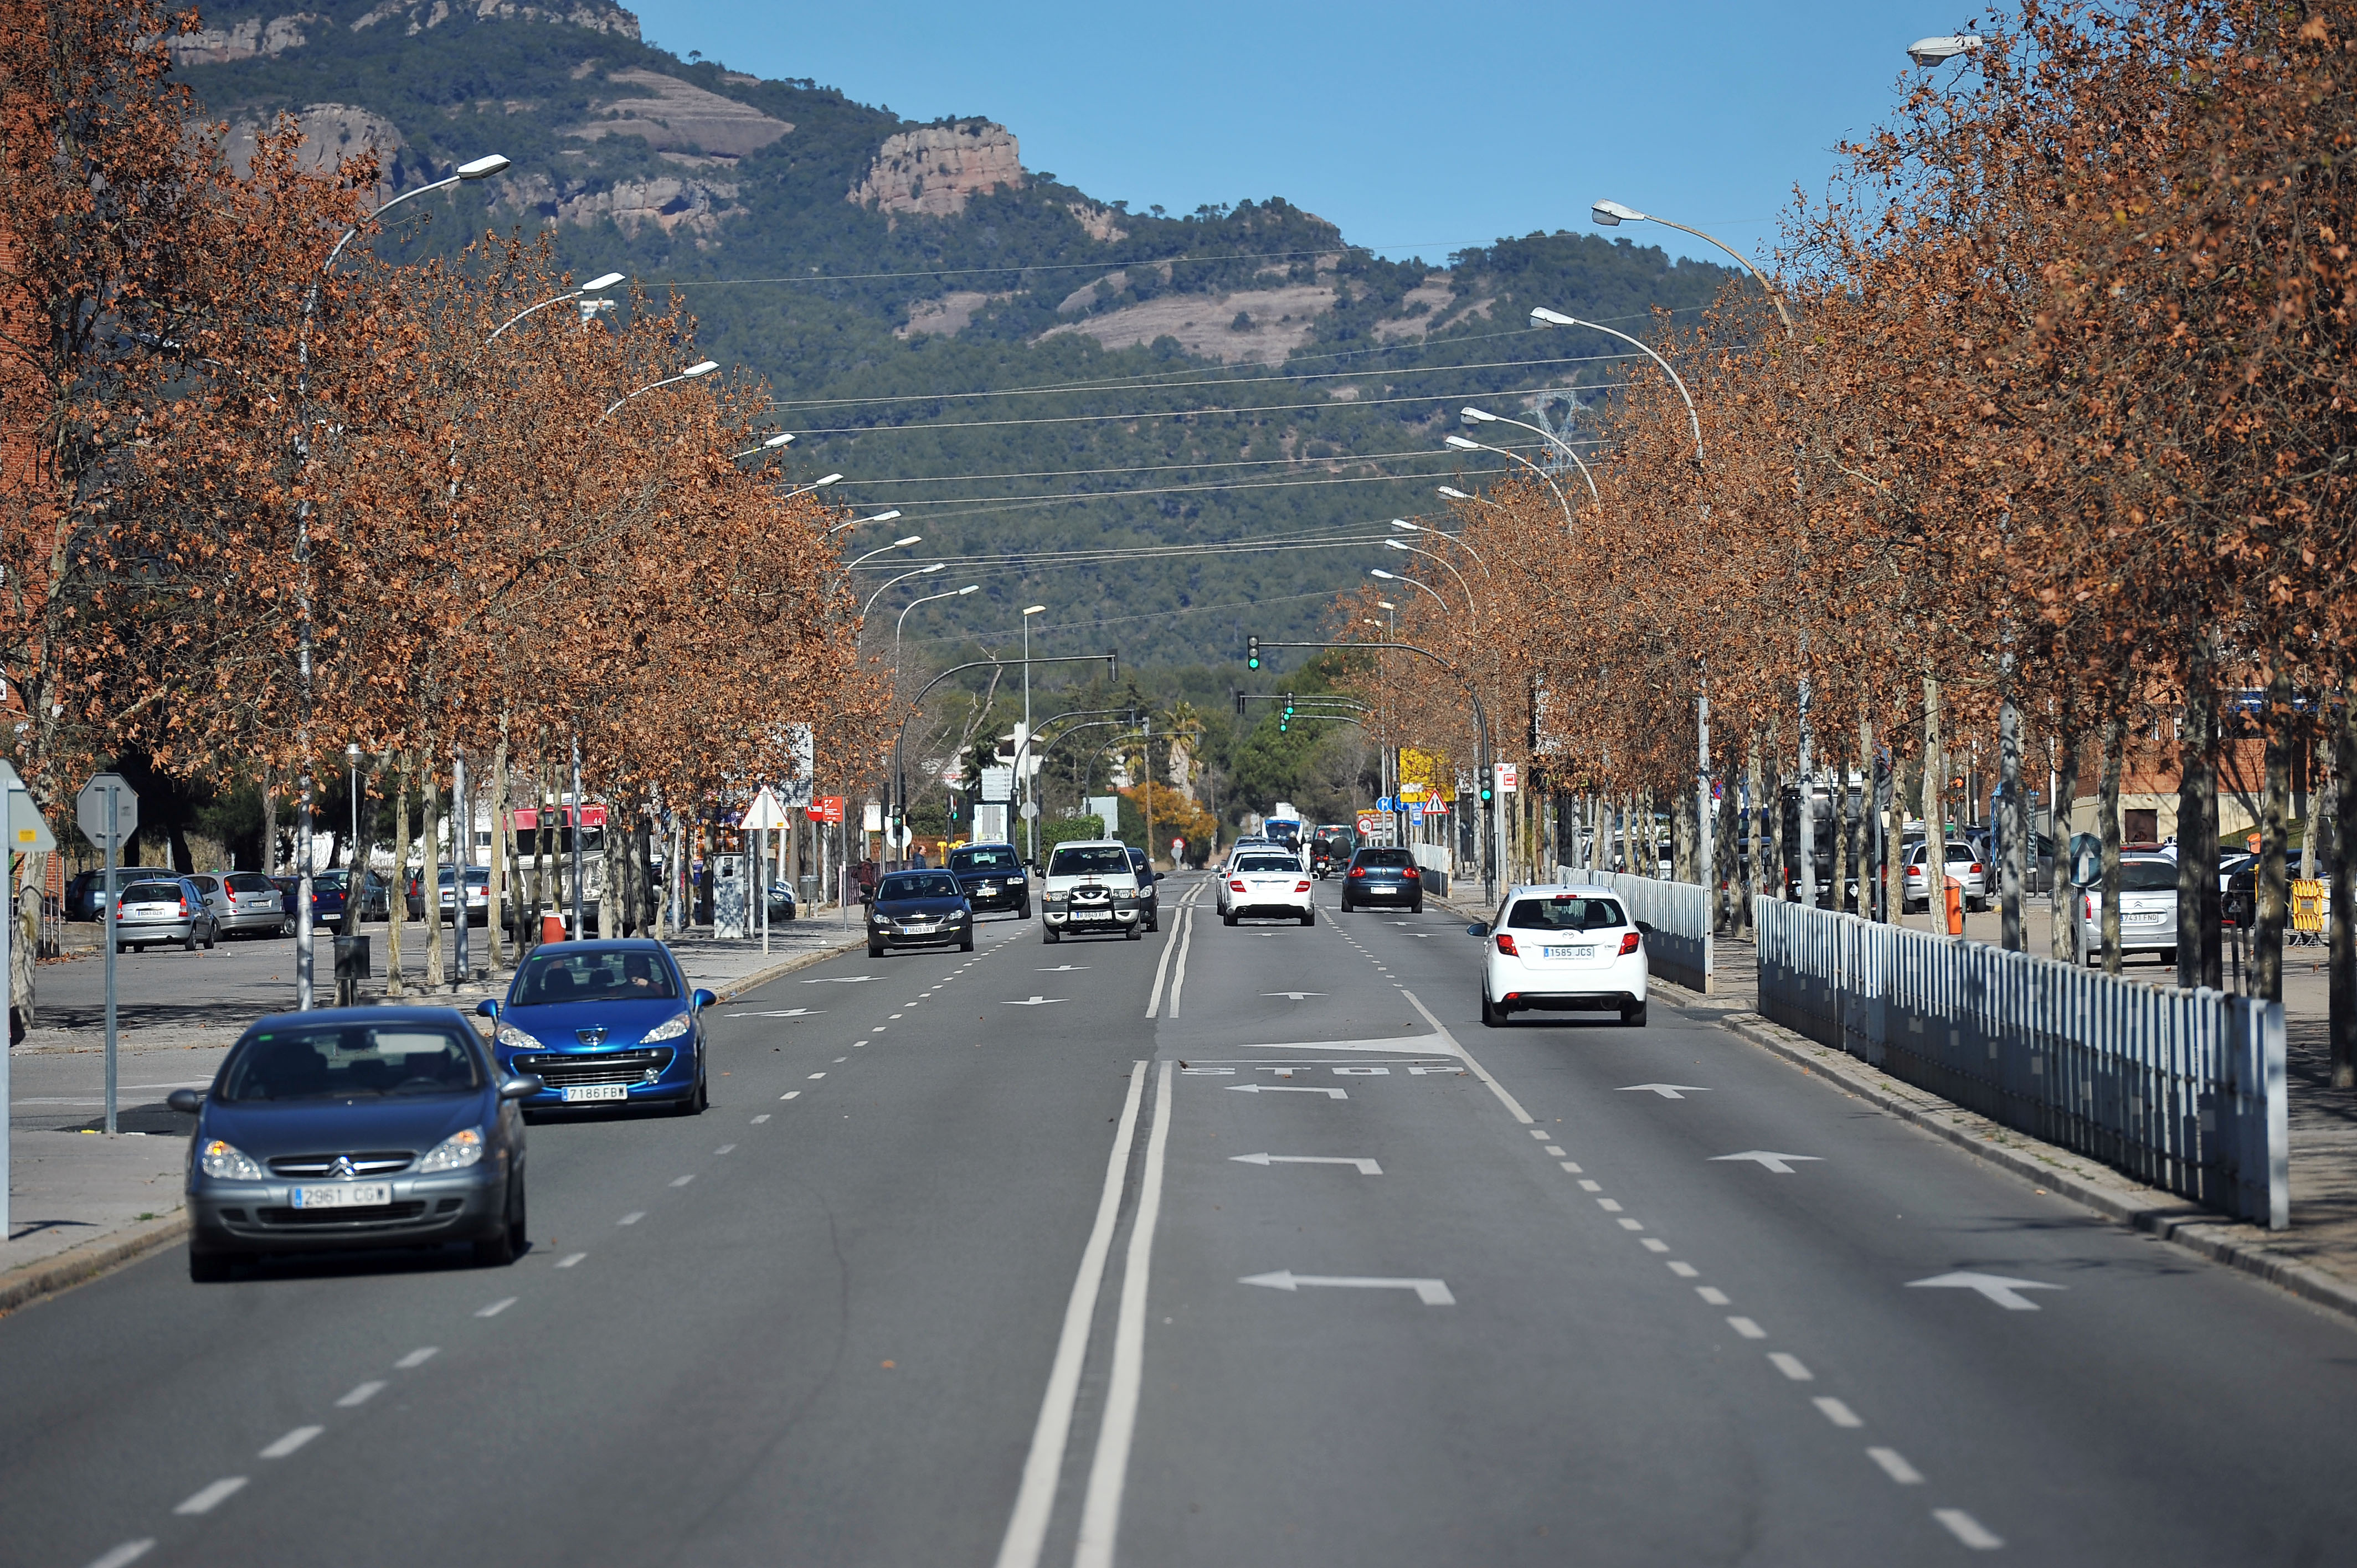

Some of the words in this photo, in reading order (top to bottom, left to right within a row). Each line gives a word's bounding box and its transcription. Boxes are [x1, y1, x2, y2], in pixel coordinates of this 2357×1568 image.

[1575, 948, 1591, 956] JCS
[1181, 1066, 1464, 1075] STOP
[570, 1089, 600, 1099] 7186
[603, 1087, 624, 1097] FBW
[304, 1189, 342, 1205] 2961
[353, 1187, 385, 1202] CGW
